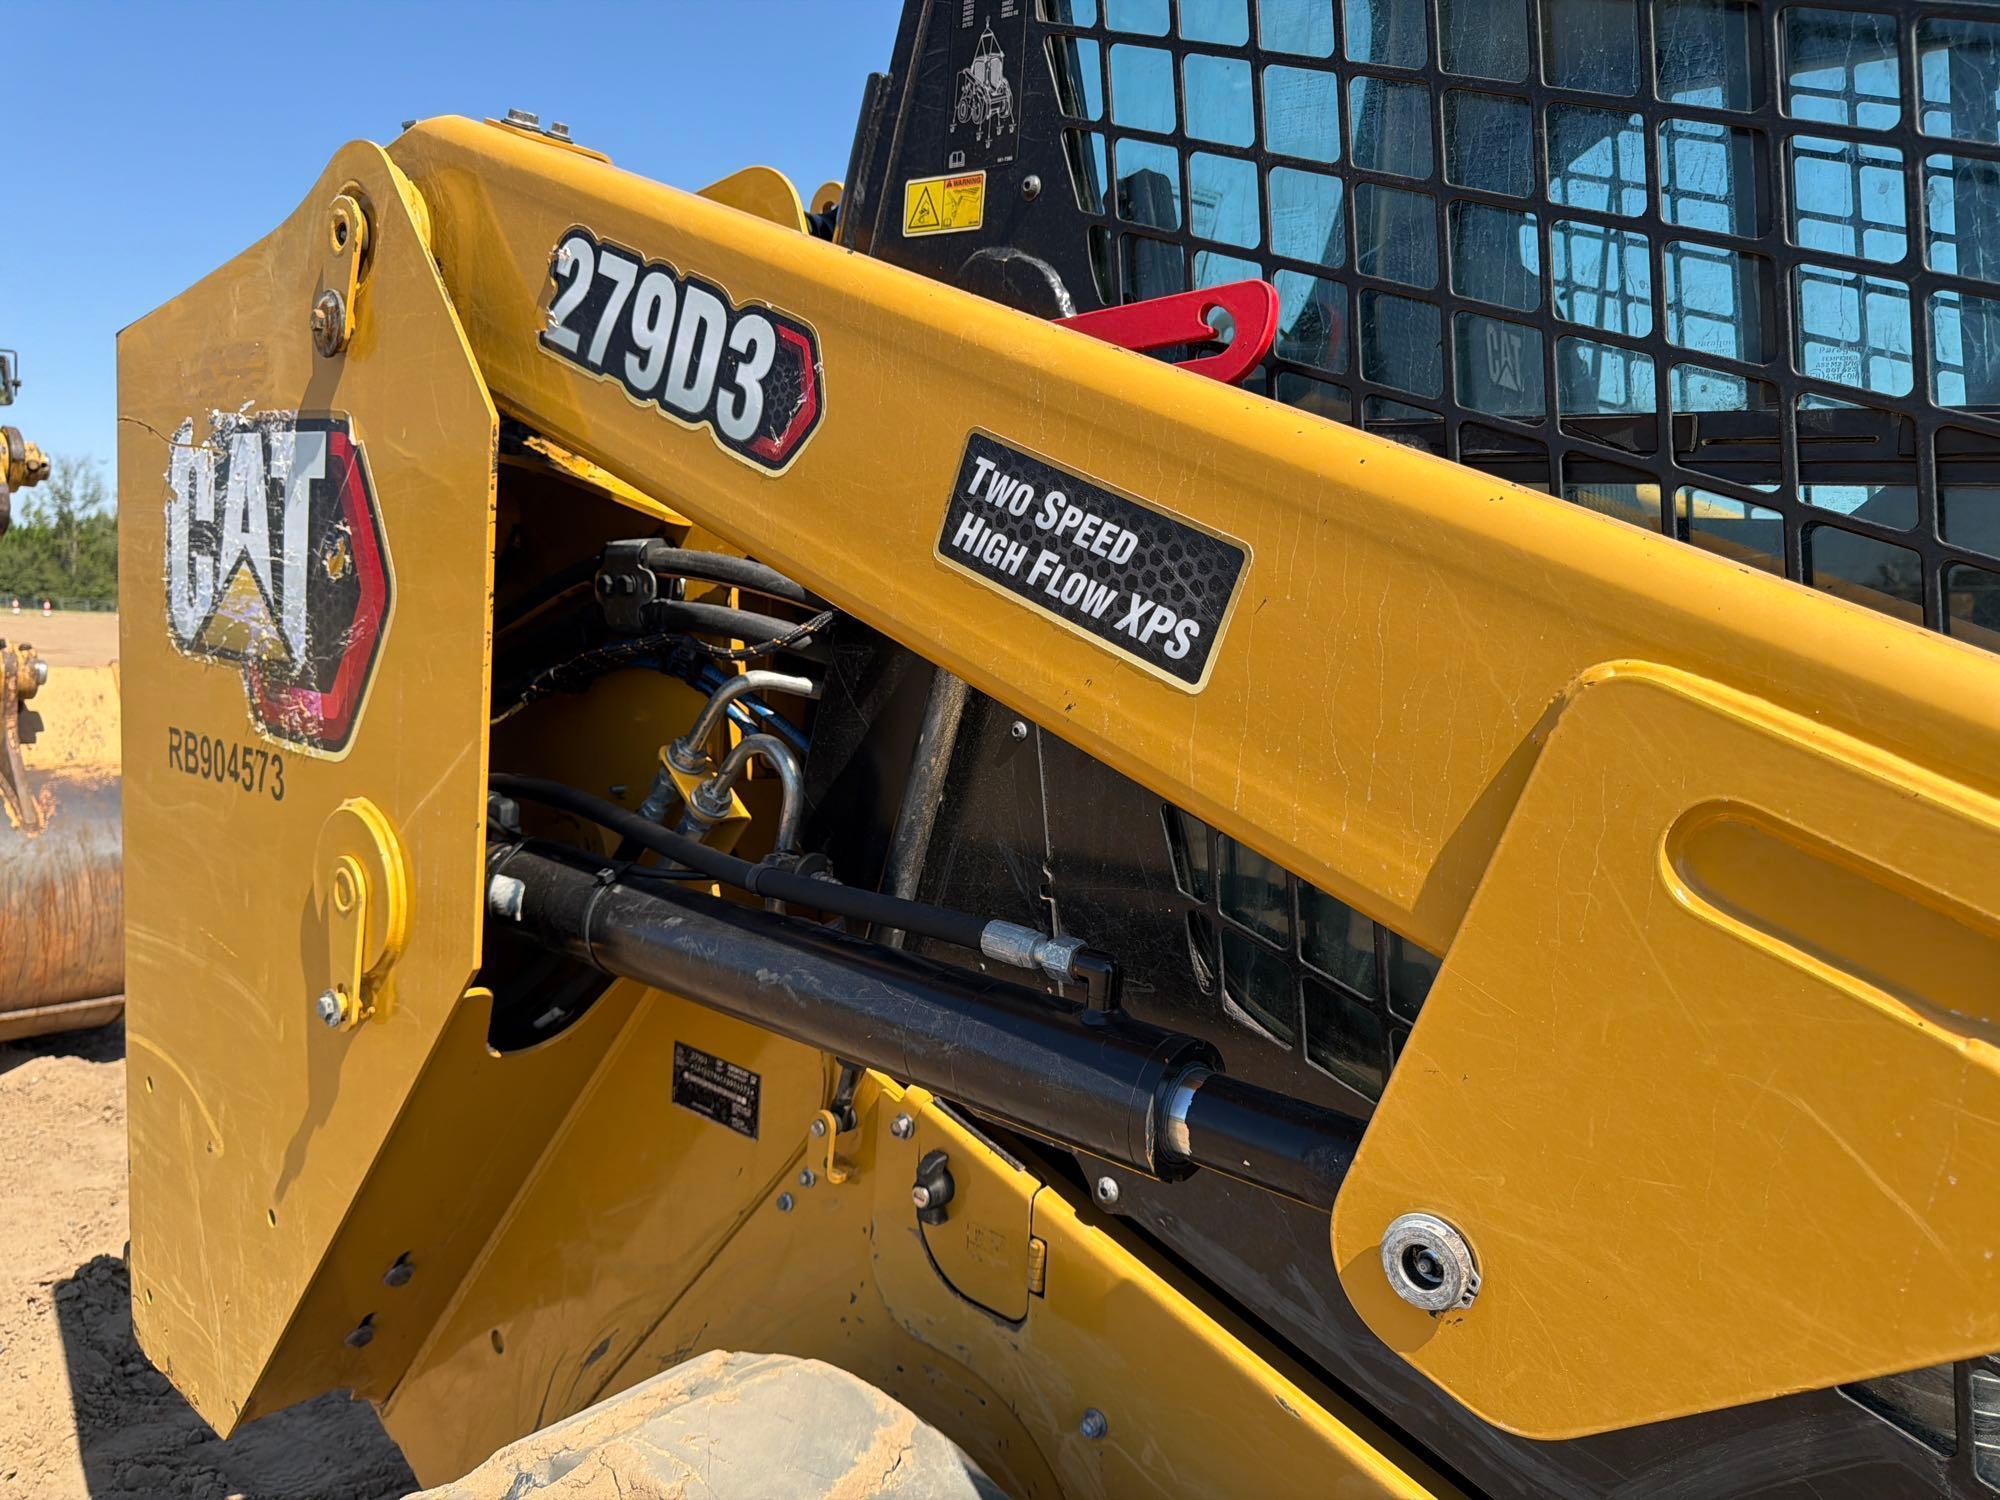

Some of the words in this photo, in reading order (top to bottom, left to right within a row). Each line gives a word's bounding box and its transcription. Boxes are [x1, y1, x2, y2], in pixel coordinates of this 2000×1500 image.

[544, 236, 776, 441] 279D3
[1486, 323, 1521, 391] CAT
[168, 418, 327, 670] CAT
[1113, 593, 1200, 660] XPS
[169, 726, 285, 801] RB904573
